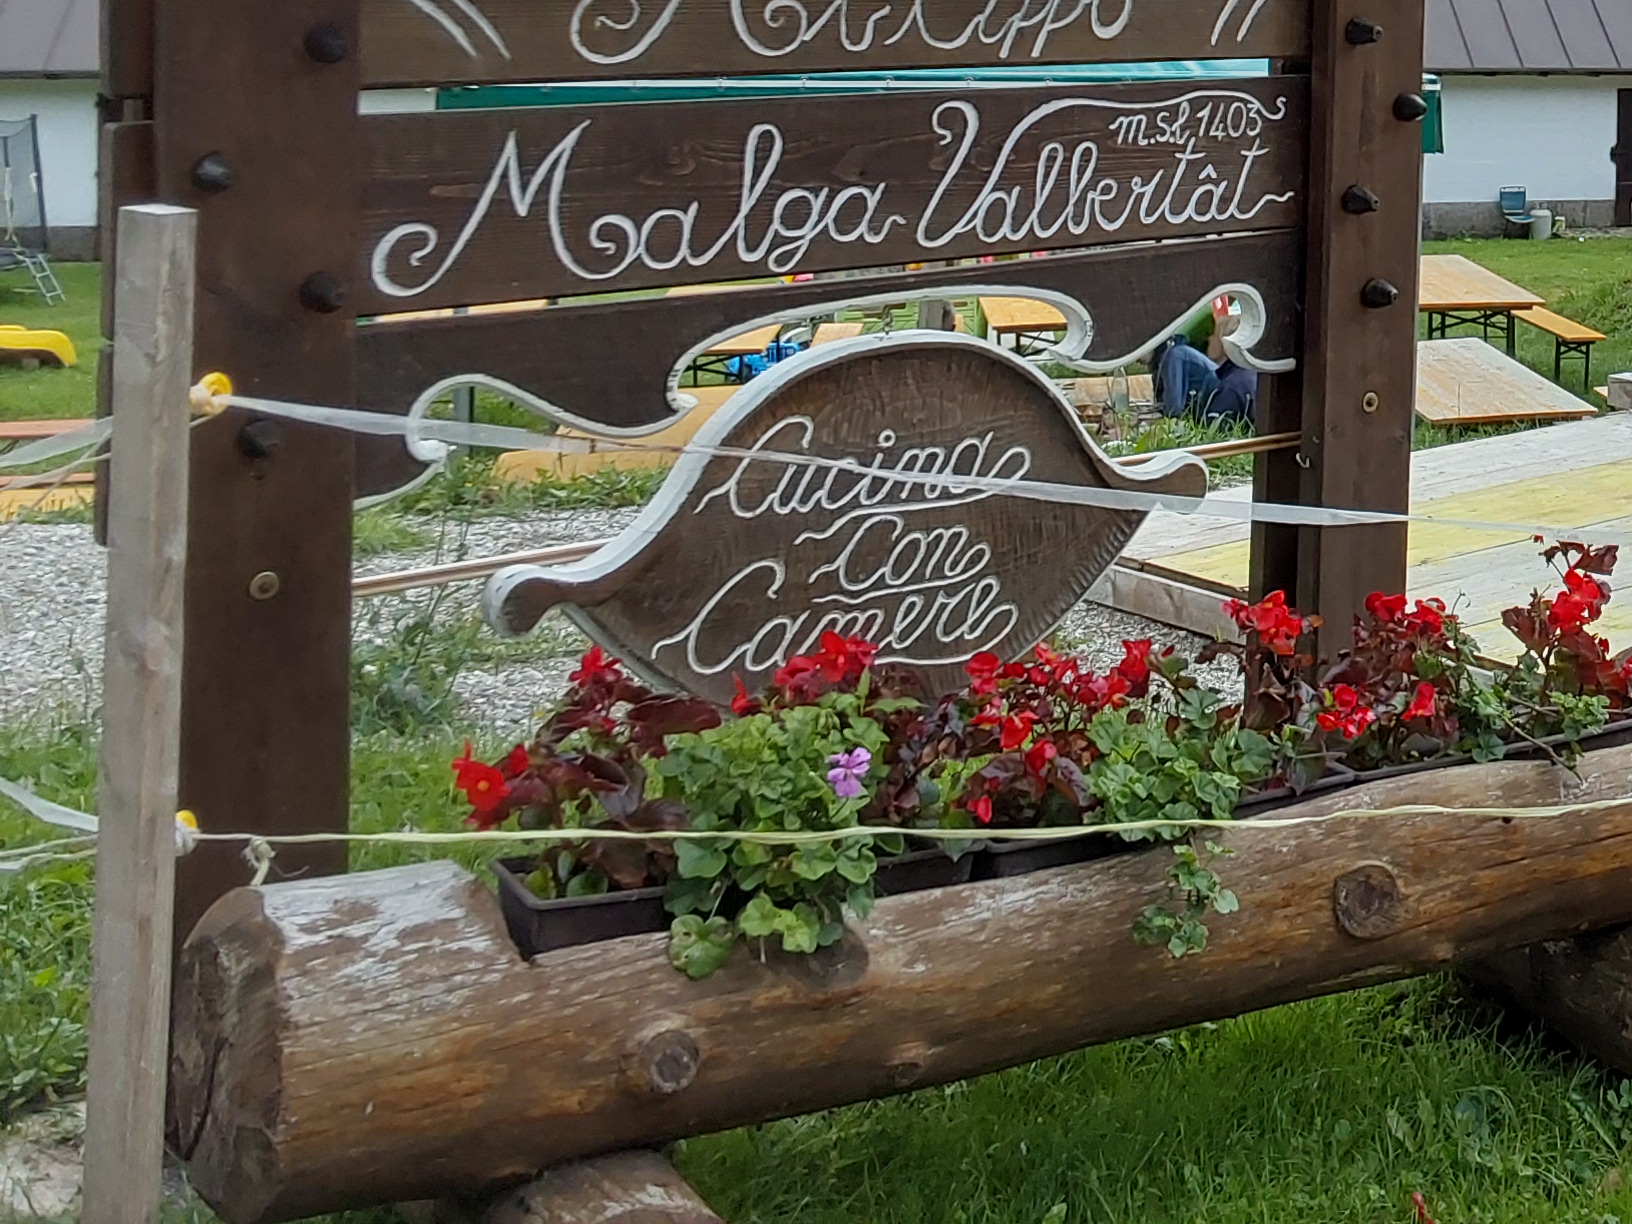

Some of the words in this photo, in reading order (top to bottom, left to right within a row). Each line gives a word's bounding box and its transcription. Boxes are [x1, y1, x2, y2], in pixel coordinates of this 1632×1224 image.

[1195, 100, 1263, 142] 1403
[370, 119, 906, 297] Malga
[916, 90, 1295, 249] Valbertât
[694, 415, 1032, 545] Cucina
[651, 557, 1020, 675] Camere
[809, 514, 992, 604] Con
